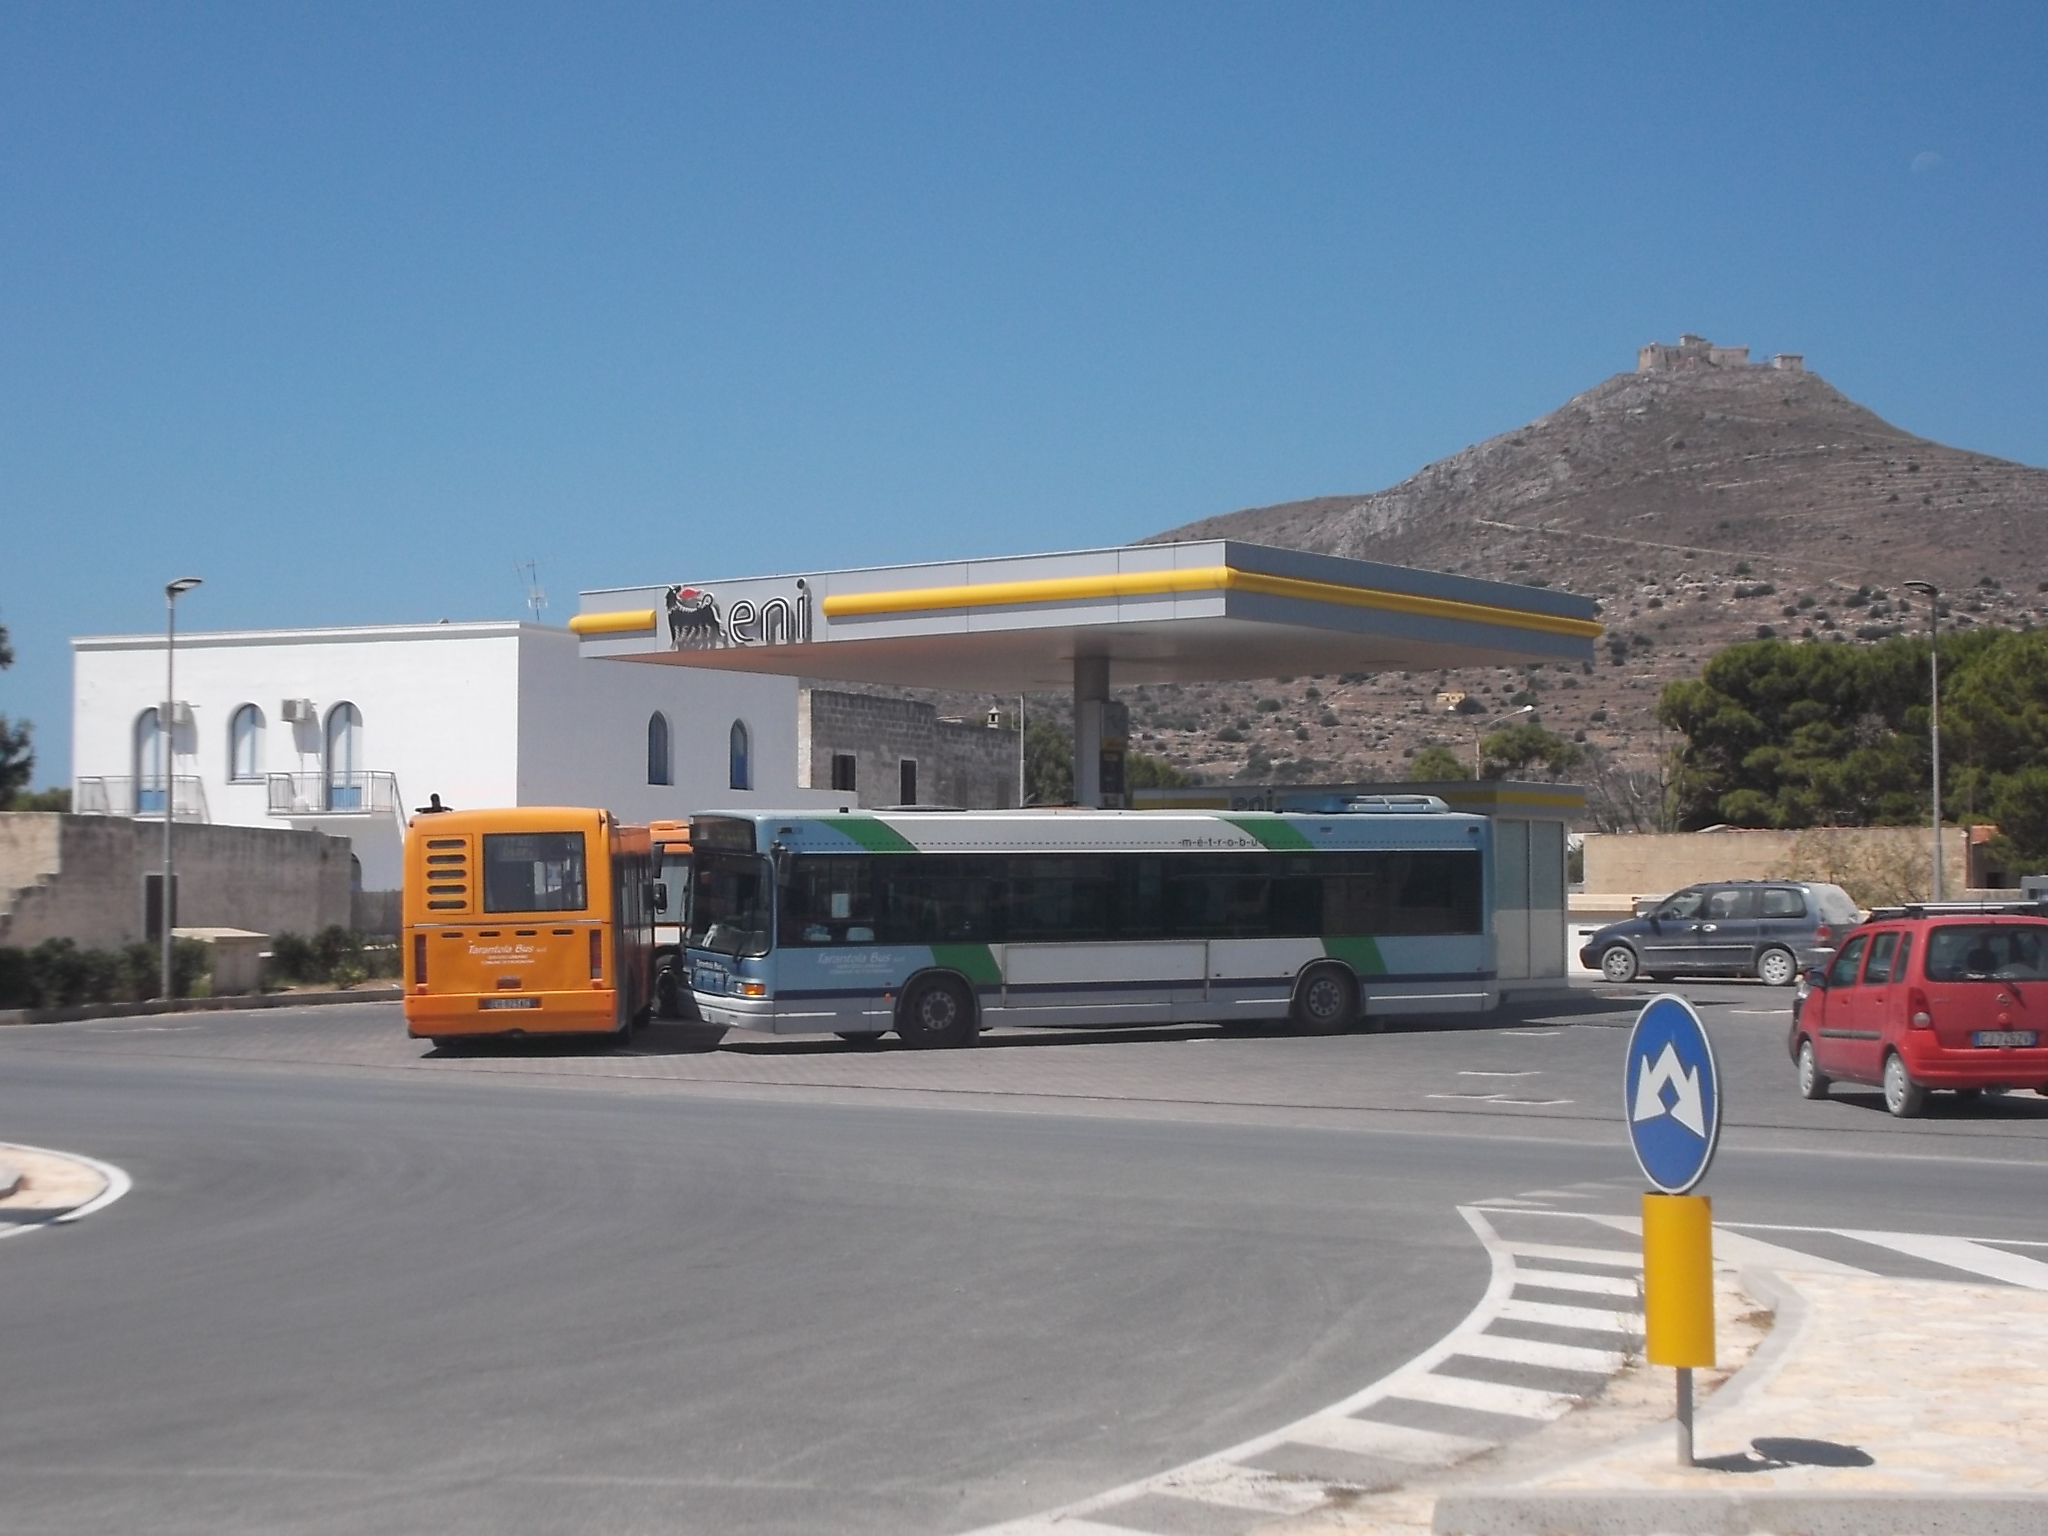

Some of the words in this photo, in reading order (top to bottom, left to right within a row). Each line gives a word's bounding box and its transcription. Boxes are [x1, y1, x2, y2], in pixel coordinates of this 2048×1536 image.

[729, 578, 806, 645] eni
[1233, 789, 1273, 811] eni
[468, 945, 513, 955] Tarantola
[515, 944, 534, 953] Bus
[818, 952, 867, 965] Tarantola
[870, 951, 891, 963] Bus
